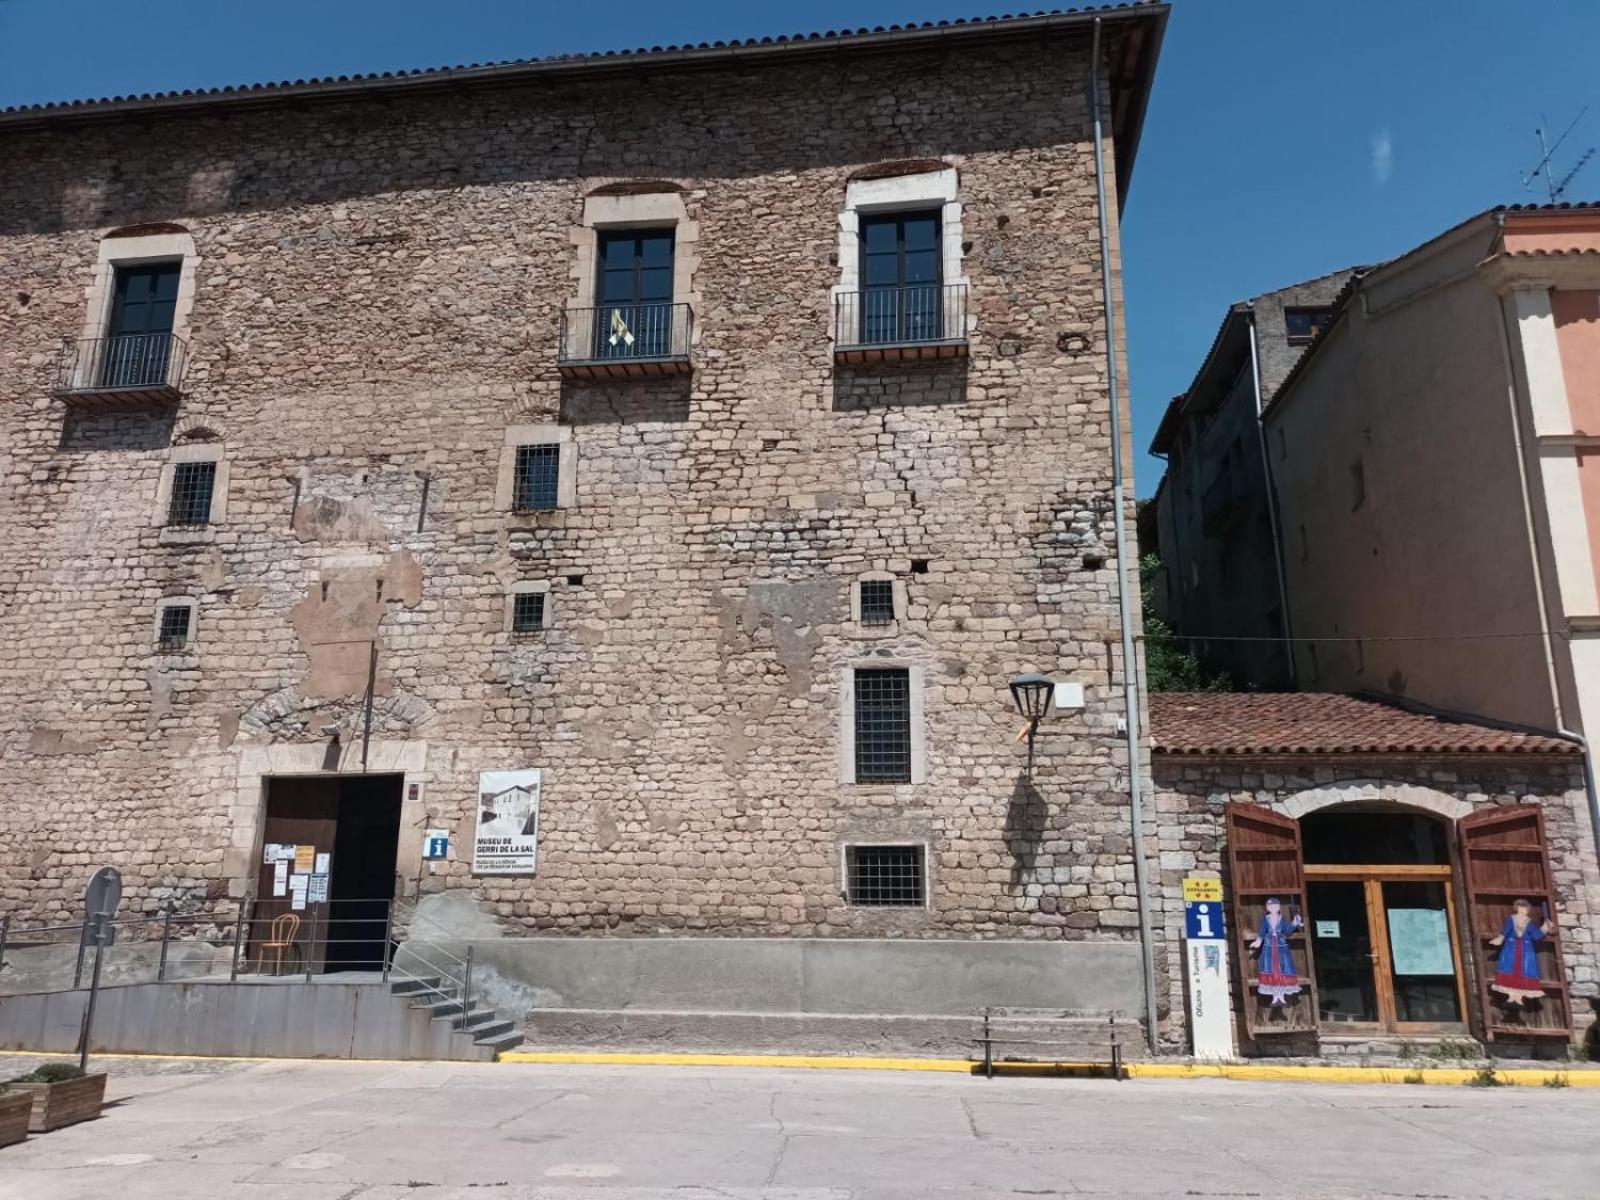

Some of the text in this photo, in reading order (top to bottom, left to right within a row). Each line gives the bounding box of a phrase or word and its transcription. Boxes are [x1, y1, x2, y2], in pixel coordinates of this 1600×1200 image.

[477, 837, 512, 845] MUSEU DE
[476, 845, 534, 853] GERRI DE LA SAL
[1195, 989, 1203, 1018] Oficina
